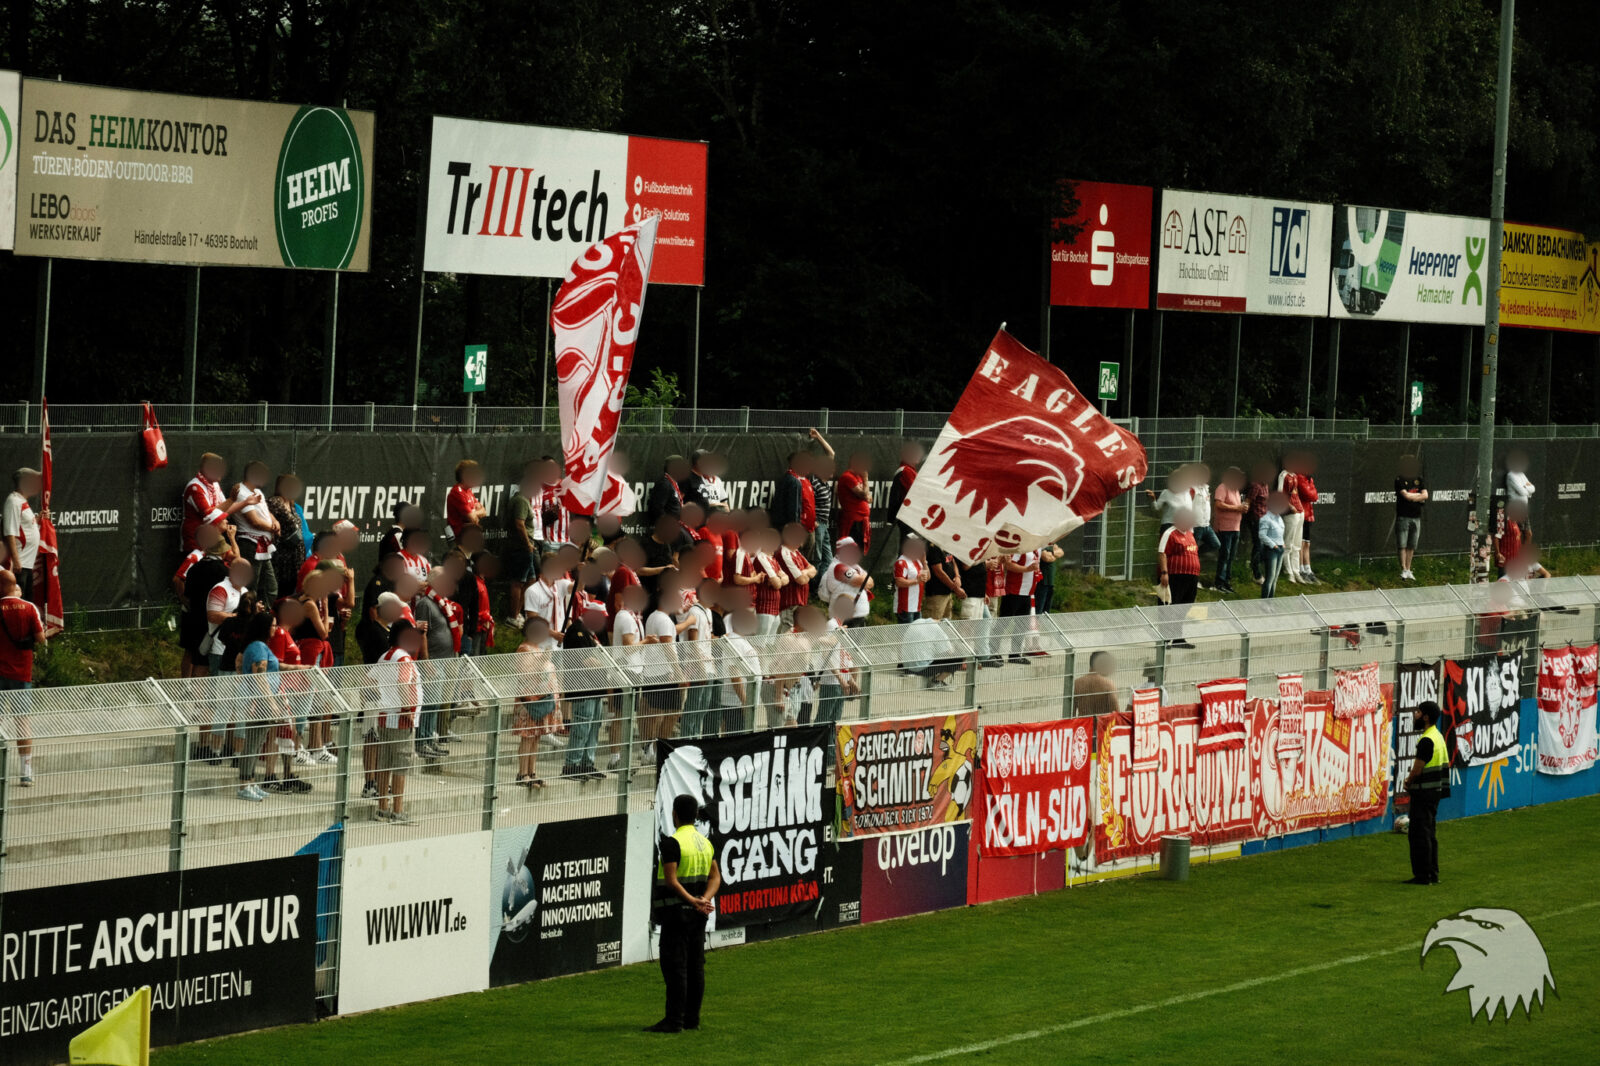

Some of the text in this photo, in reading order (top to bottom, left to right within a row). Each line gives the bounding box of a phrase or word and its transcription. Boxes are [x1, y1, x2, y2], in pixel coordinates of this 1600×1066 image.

[287, 157, 351, 209] HEIM
[643, 181, 694, 196] Fußbodentechnik
[301, 201, 339, 229] PROFIS
[664, 208, 690, 222] Solutions
[29, 224, 102, 243] WERKSVERKAUF
[134, 230, 258, 251] Händelstraße 17 46395 Bocholt
[1184, 207, 1228, 257] ASF
[1051, 250, 1061, 262] Gut
[1069, 252, 1088, 264] Bocholt
[1115, 252, 1149, 267] Stadtsparkasse
[1408, 246, 1462, 278] Heppner
[1536, 234, 1587, 262] BEDACHUNGEN
[1178, 262, 1229, 282] Hochbau GmbH
[1502, 263, 1562, 290] Dachdeckermeister
[1267, 292, 1306, 308] www.idst.de
[1416, 283, 1454, 304] Hamacher
[979, 349, 1139, 490] EAGLES
[304, 485, 370, 520] EVENT
[58, 510, 119, 526] ARCHITEKTUR
[856, 728, 934, 762] GENERATION
[1475, 711, 1519, 755] ON TOUR
[718, 735, 824, 834] SCHÄNG
[854, 758, 933, 809] SCHMITZ
[985, 775, 1087, 849] KÖLN-SÜD
[543, 856, 609, 881] AUS TEXTILIEN
[720, 828, 818, 886] GÄNG
[542, 880, 601, 905] MACHEN WIR
[719, 878, 819, 915] NUR FORTUNA KÖLN
[366, 897, 467, 946] WWLWWT.de
[541, 900, 614, 928] INNOVATIONEN.
[89, 894, 300, 970] ARCHITEKTUR
[720, 930, 743, 942] tec-knit.de
[150, 970, 243, 1012] AUWELTEN
